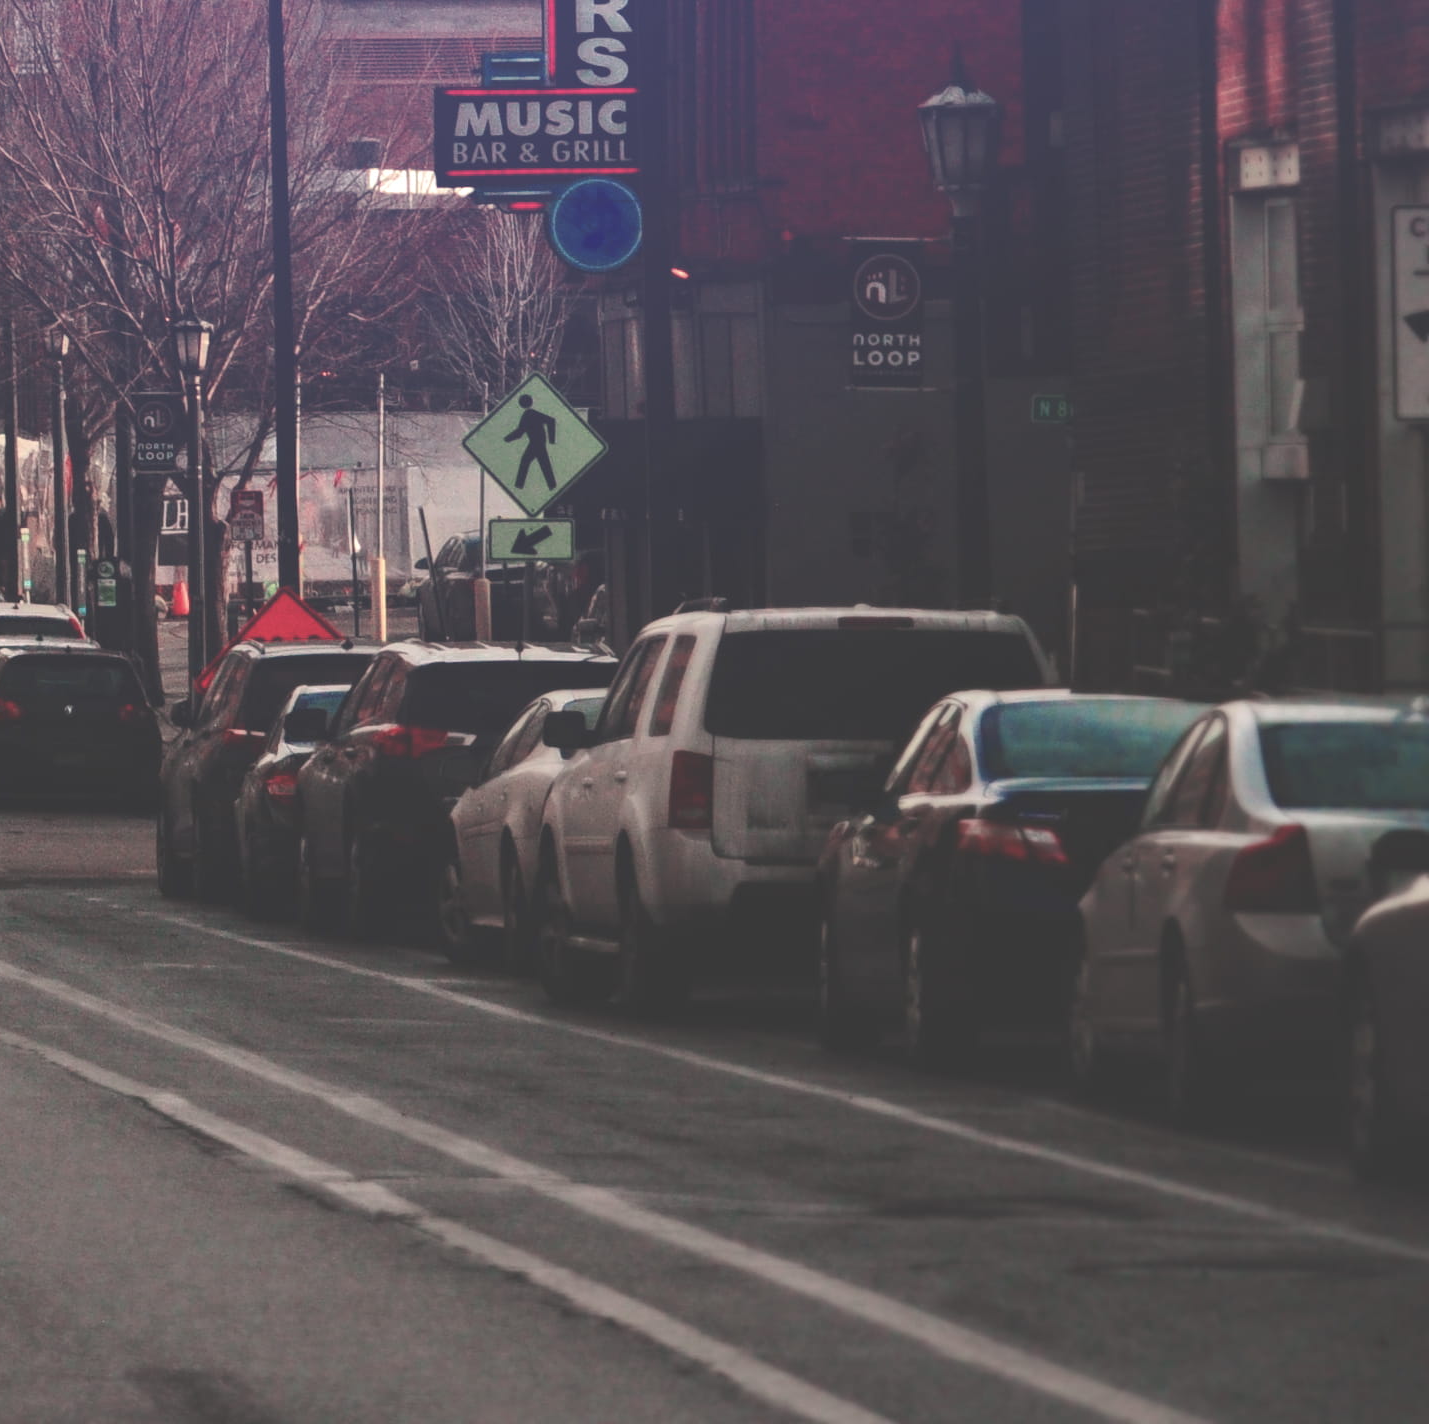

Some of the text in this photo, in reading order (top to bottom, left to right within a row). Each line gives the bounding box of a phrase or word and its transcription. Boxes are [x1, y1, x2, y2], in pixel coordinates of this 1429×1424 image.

[454, 100, 627, 136] MUSIC
[453, 139, 631, 164] BAR & GRILL
[853, 351, 920, 366] LOOP
[138, 451, 173, 461] LOOP
